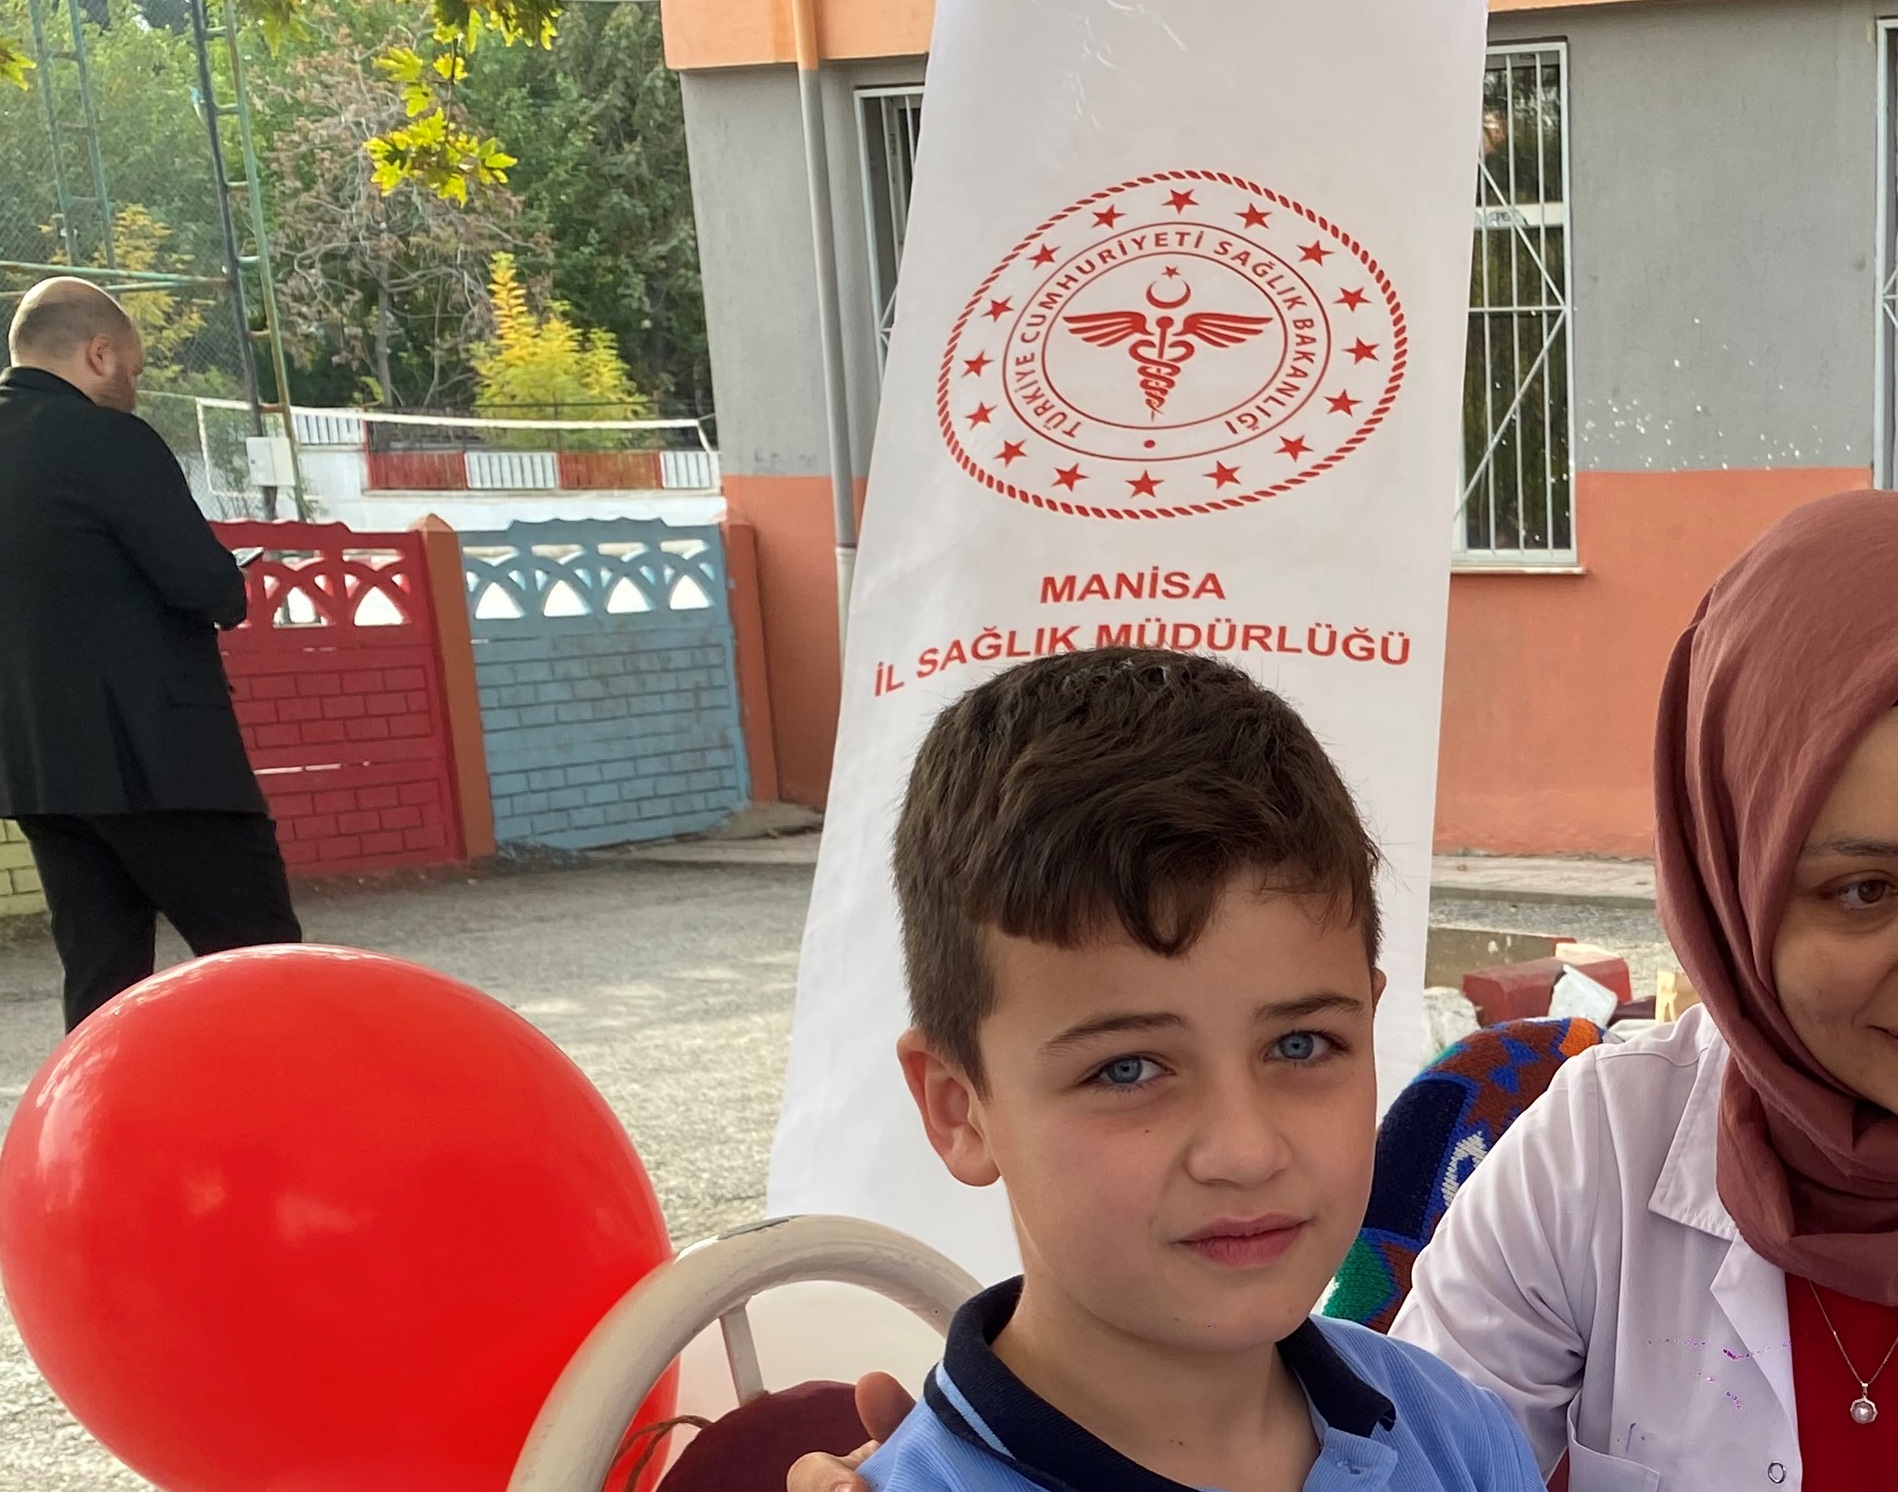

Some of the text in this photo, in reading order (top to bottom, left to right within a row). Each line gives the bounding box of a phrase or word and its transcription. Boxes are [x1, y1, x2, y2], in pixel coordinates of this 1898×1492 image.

[1014, 230, 1318, 439] TÜRKİYE CUMHURİYETİ SAĞLIK BAKANLIĞI
[1039, 565, 1227, 605] MANİSA
[873, 617, 1411, 698] İL SAĞLIK MÜDÜRLÜĞÜ
